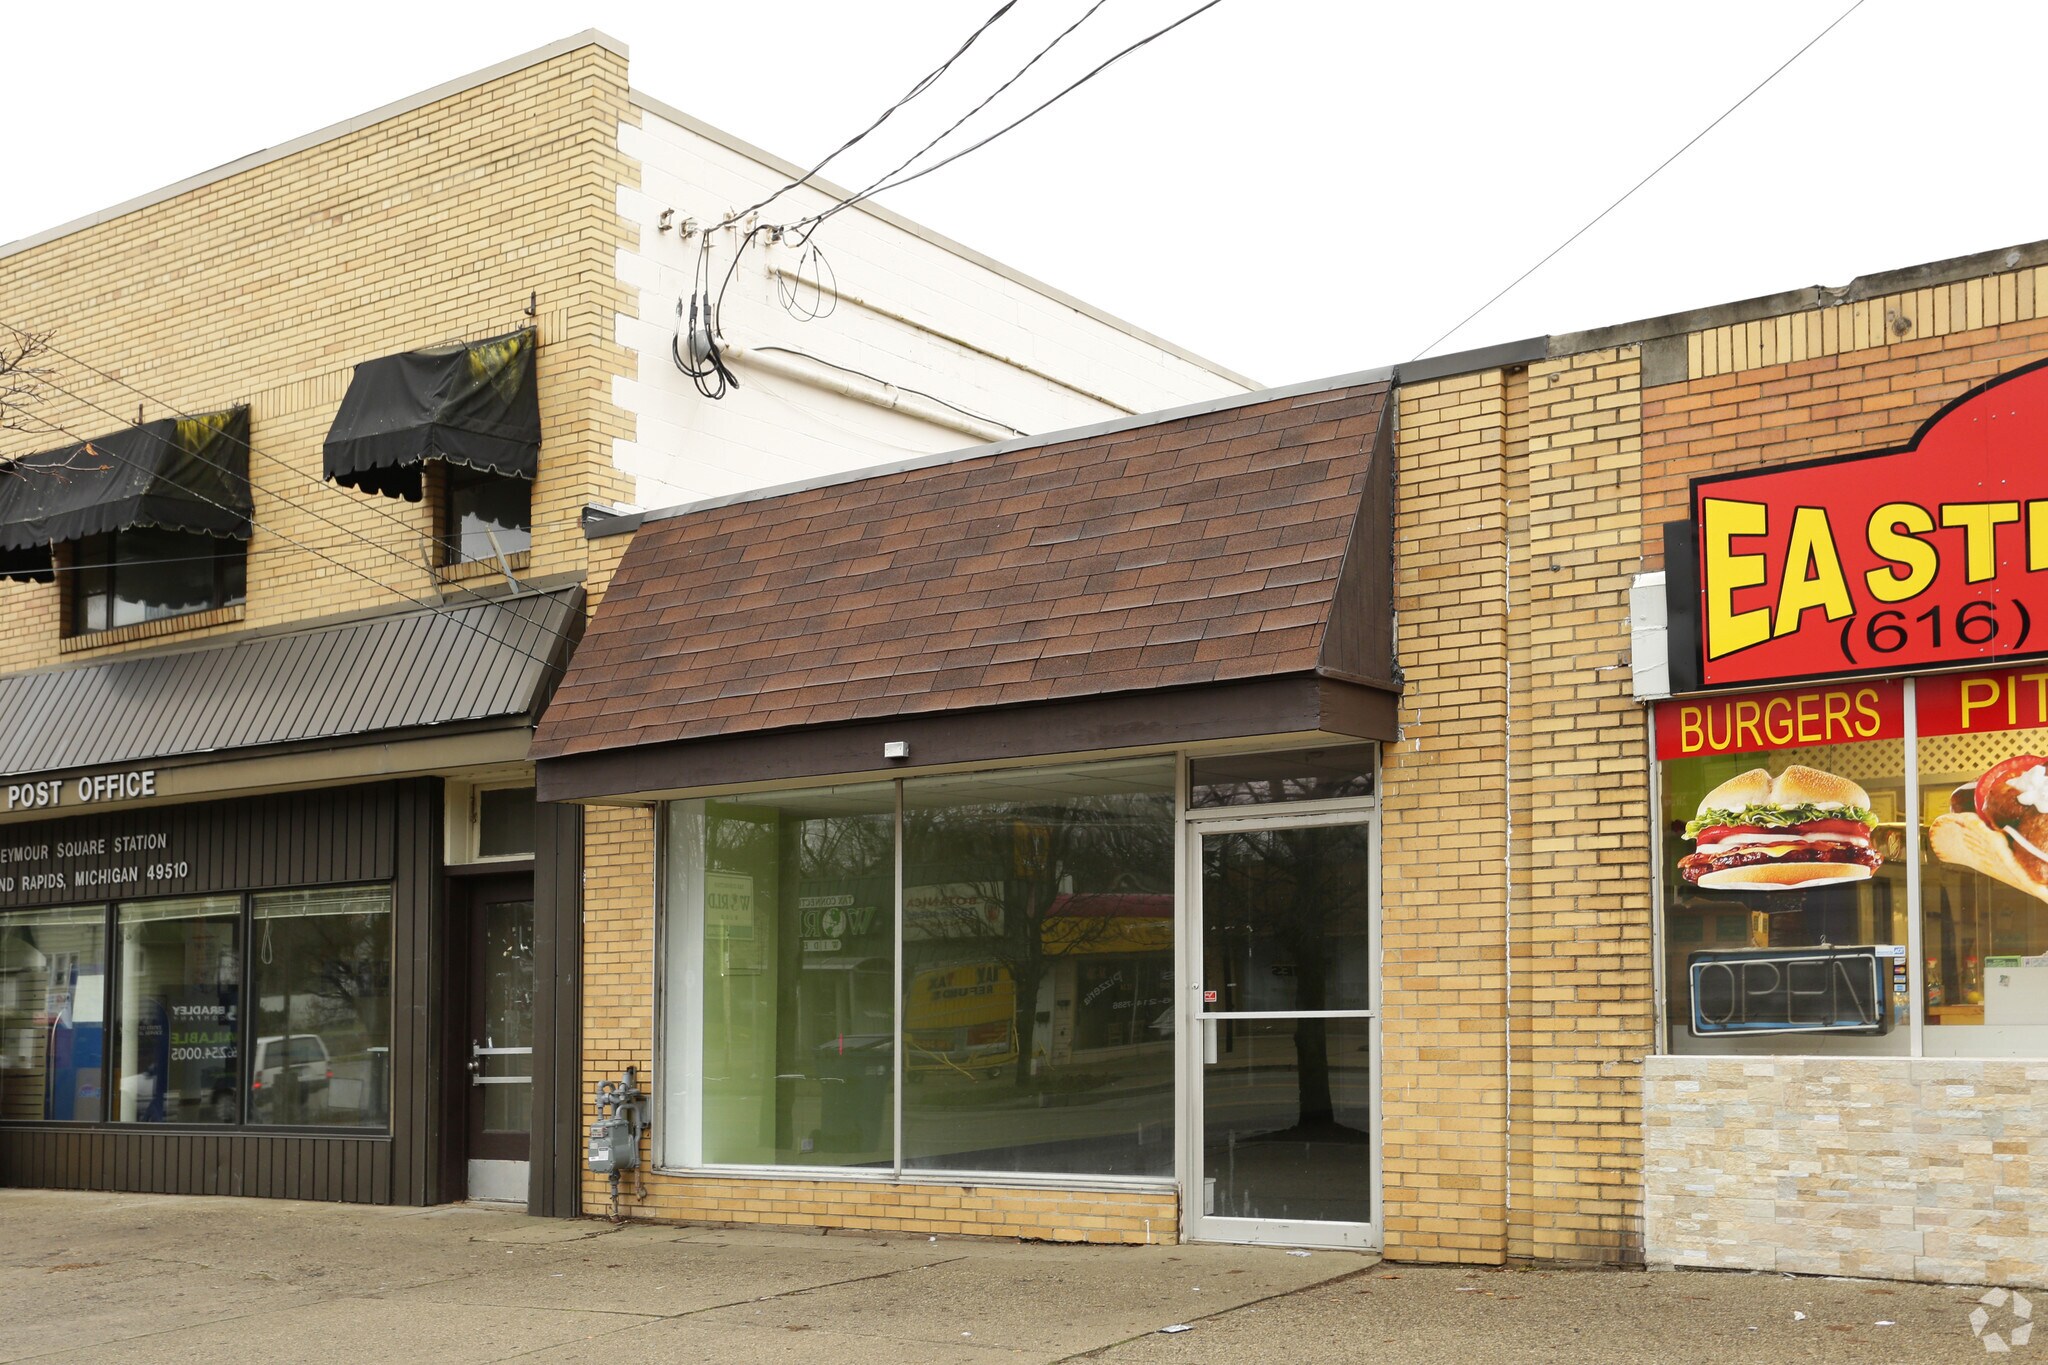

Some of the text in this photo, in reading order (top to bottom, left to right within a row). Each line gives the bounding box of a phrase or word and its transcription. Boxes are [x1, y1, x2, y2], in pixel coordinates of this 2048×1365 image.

[1703, 496, 2048, 662] EAST
[1840, 598, 2031, 665] (616)
[1680, 688, 1881, 753] BURGERS
[8, 770, 155, 809] POST OFFICE
[0, 833, 167, 863] EYMOUR SQUARE STATION
[22, 873, 67, 891] RAPIDS,
[75, 866, 138, 887] MICHIGAN
[147, 861, 188, 880] 49510
[1699, 960, 1873, 1025] OPEN
